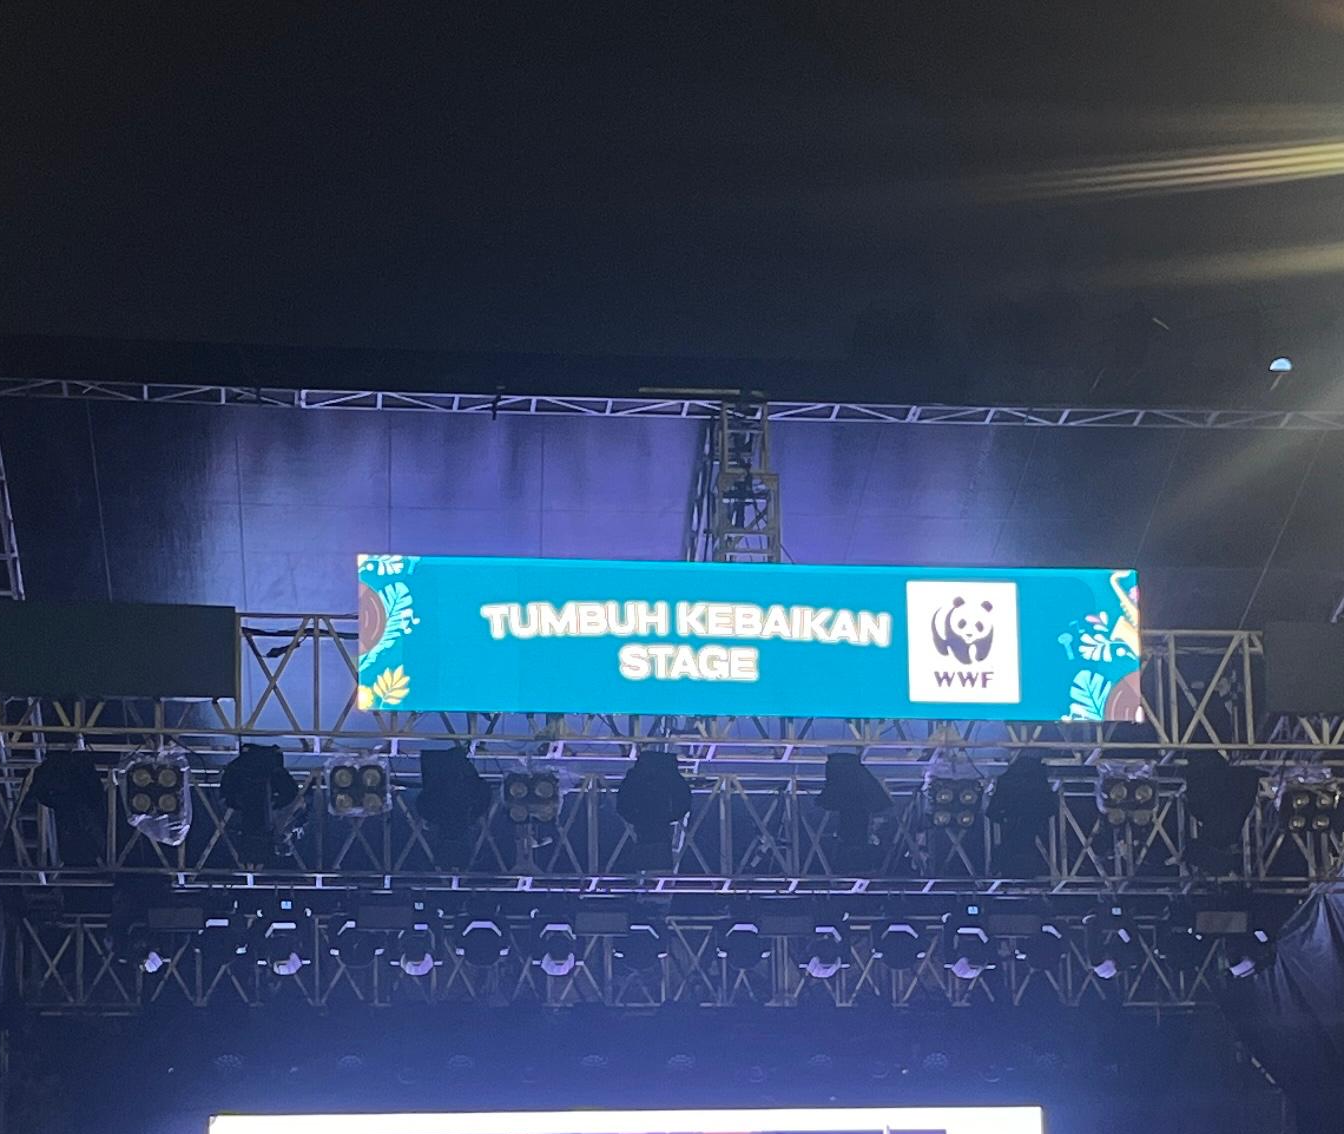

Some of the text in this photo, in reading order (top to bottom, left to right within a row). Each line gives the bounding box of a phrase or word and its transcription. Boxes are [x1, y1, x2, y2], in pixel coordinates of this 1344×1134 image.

[480, 600, 891, 647] TUMBUH KEBAIKAN
[619, 643, 759, 682] STAGE
[934, 669, 994, 689] WWF
